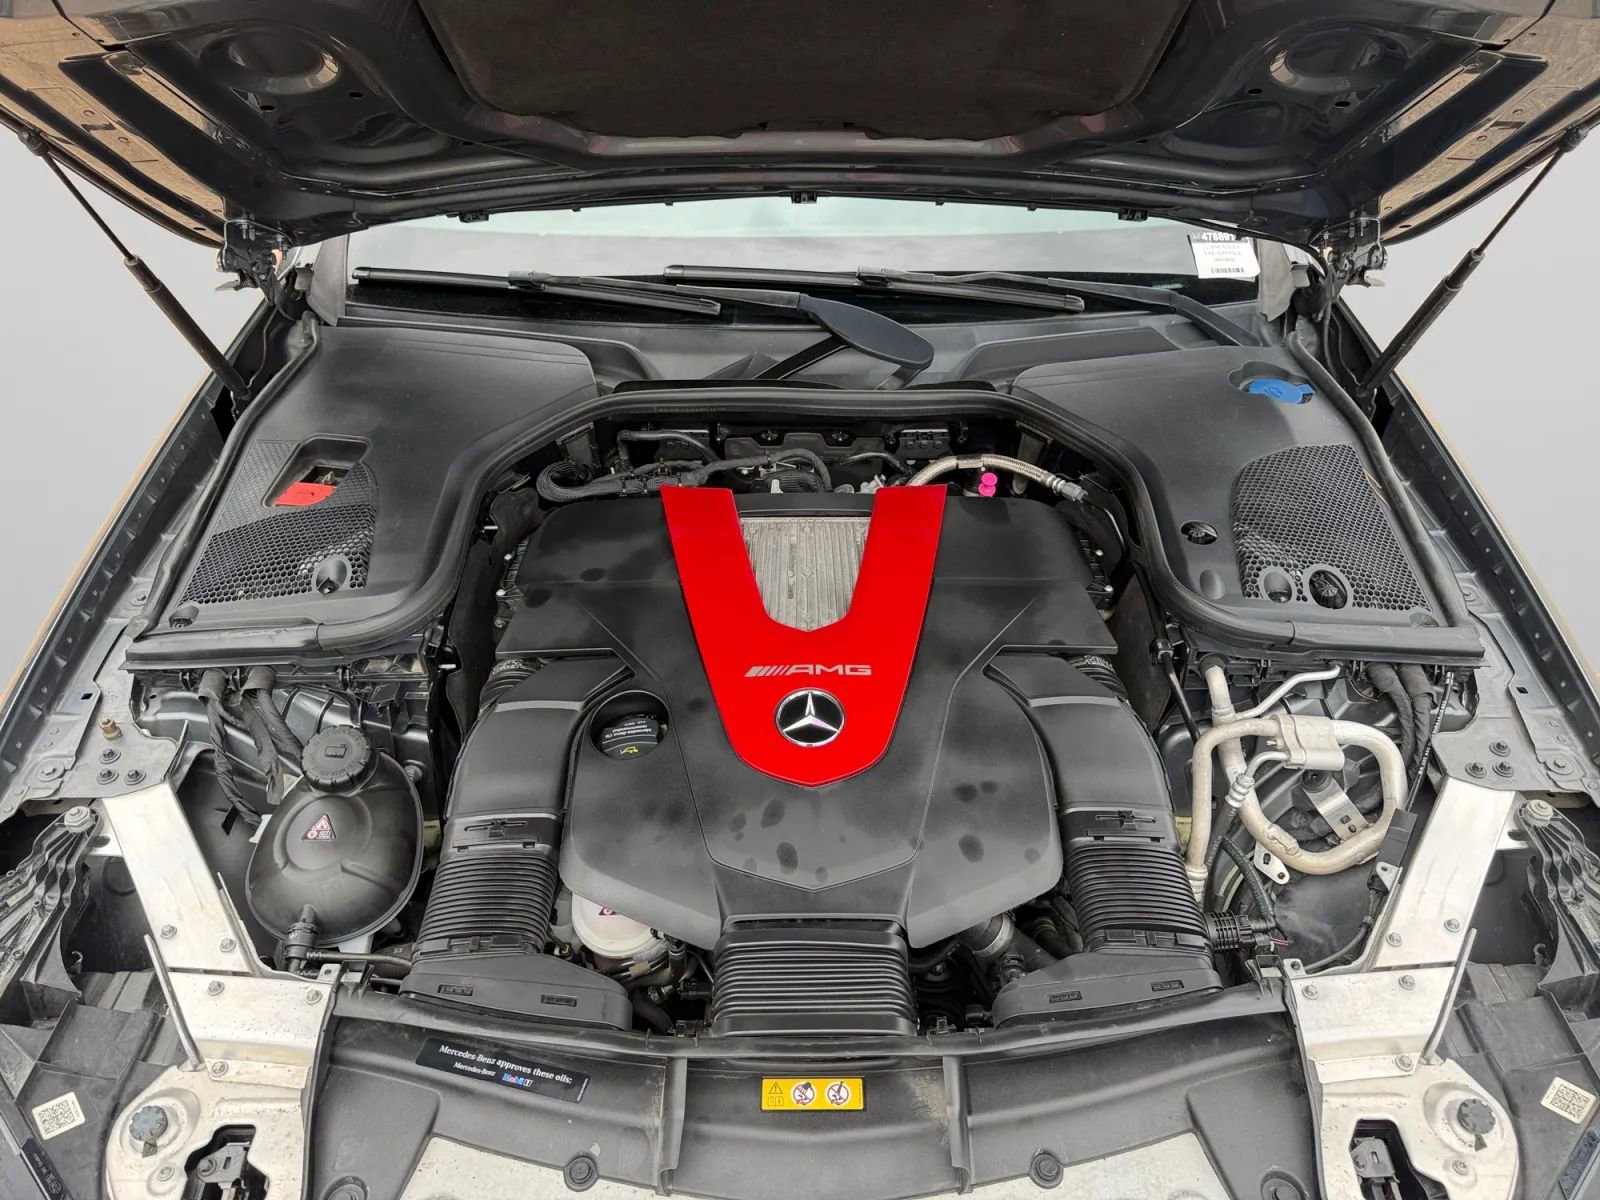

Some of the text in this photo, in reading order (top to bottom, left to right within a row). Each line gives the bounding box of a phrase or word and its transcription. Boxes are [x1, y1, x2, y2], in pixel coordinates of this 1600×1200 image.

[786, 664, 872, 676] AMG
[439, 1045, 573, 1084] Mercedes-Benz approves these oils:
[453, 1062, 496, 1076] Mercedes-Benz
[502, 1072, 524, 1086] Mobil
